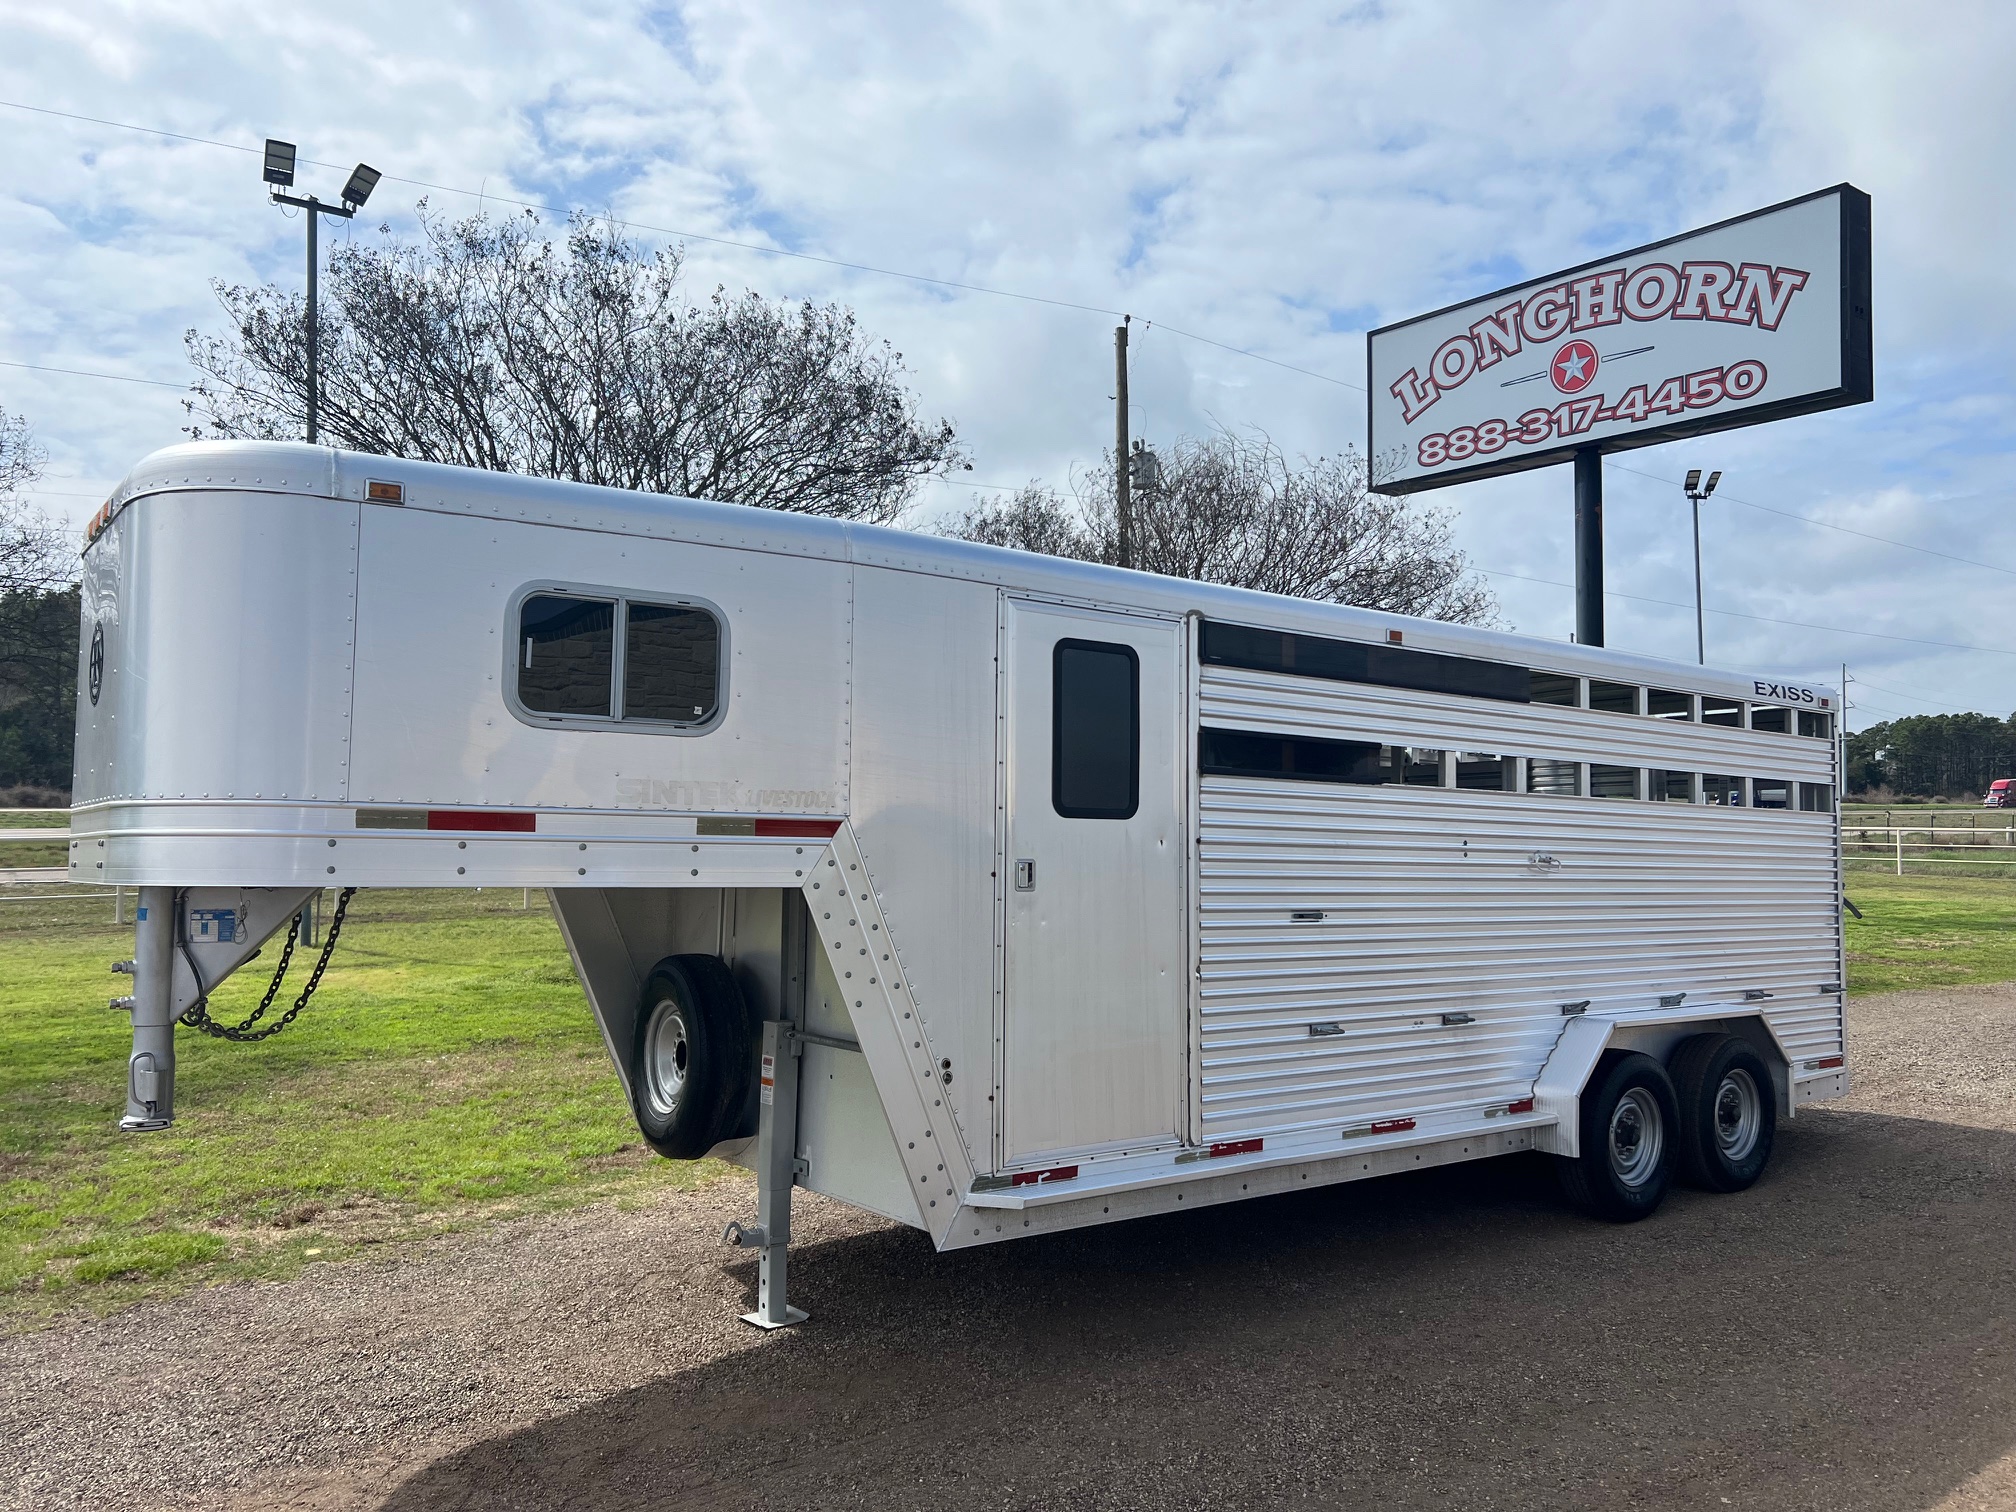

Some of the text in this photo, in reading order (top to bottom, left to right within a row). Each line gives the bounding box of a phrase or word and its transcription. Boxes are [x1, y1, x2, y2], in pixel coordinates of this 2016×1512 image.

[1390, 260, 1810, 424] LONGHORN
[1417, 359, 1768, 467] 888-317-4450
[1754, 681, 1814, 703] EXISS
[745, 788, 839, 808] LIVESTOCK
